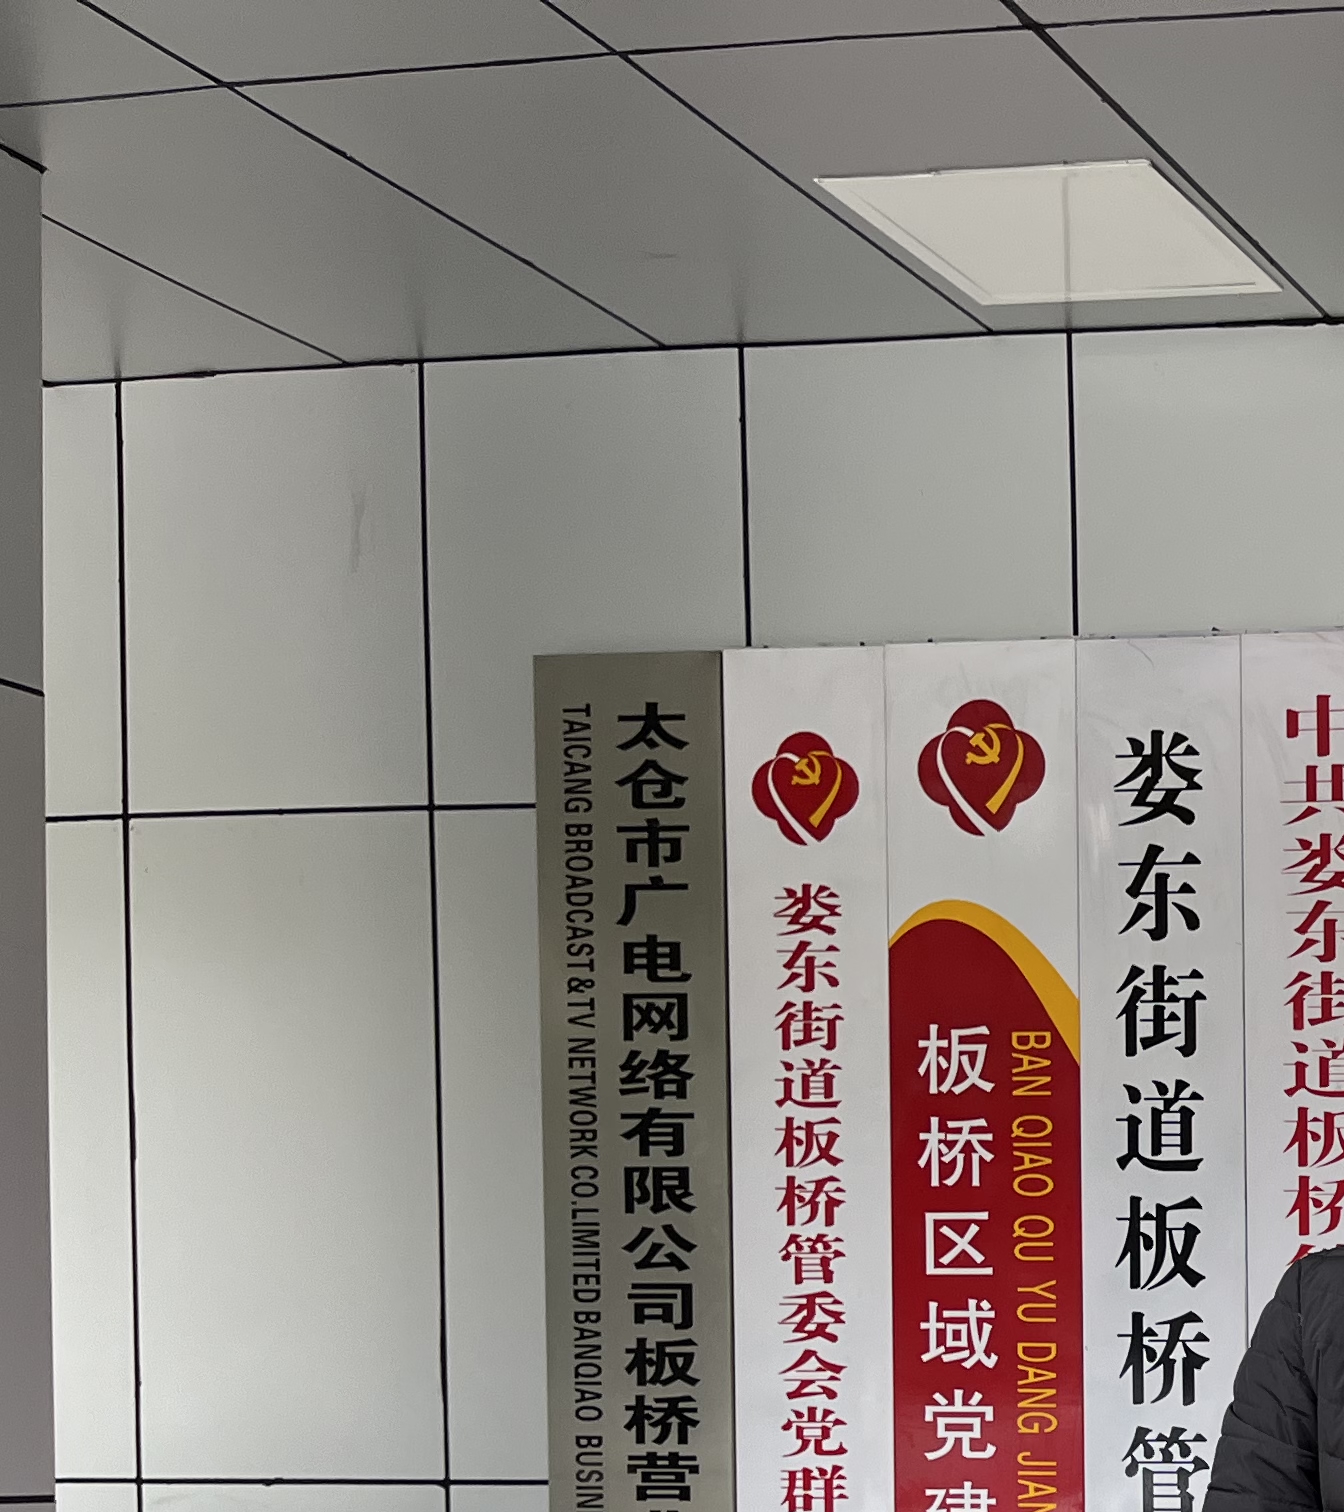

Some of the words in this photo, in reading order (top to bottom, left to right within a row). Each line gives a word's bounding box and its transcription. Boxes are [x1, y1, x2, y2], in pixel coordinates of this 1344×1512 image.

[562, 702, 592, 812] TAICANG
[568, 1037, 597, 1159] NETWORK
[1012, 1031, 1052, 1096] BAN
[1012, 1115, 1054, 1197] QIAO
[1014, 1215, 1055, 1261] QU
[1016, 1280, 1057, 1323] YU
[573, 1310, 603, 1421] BANQIAO
[1017, 1341, 1058, 1434] DANG
